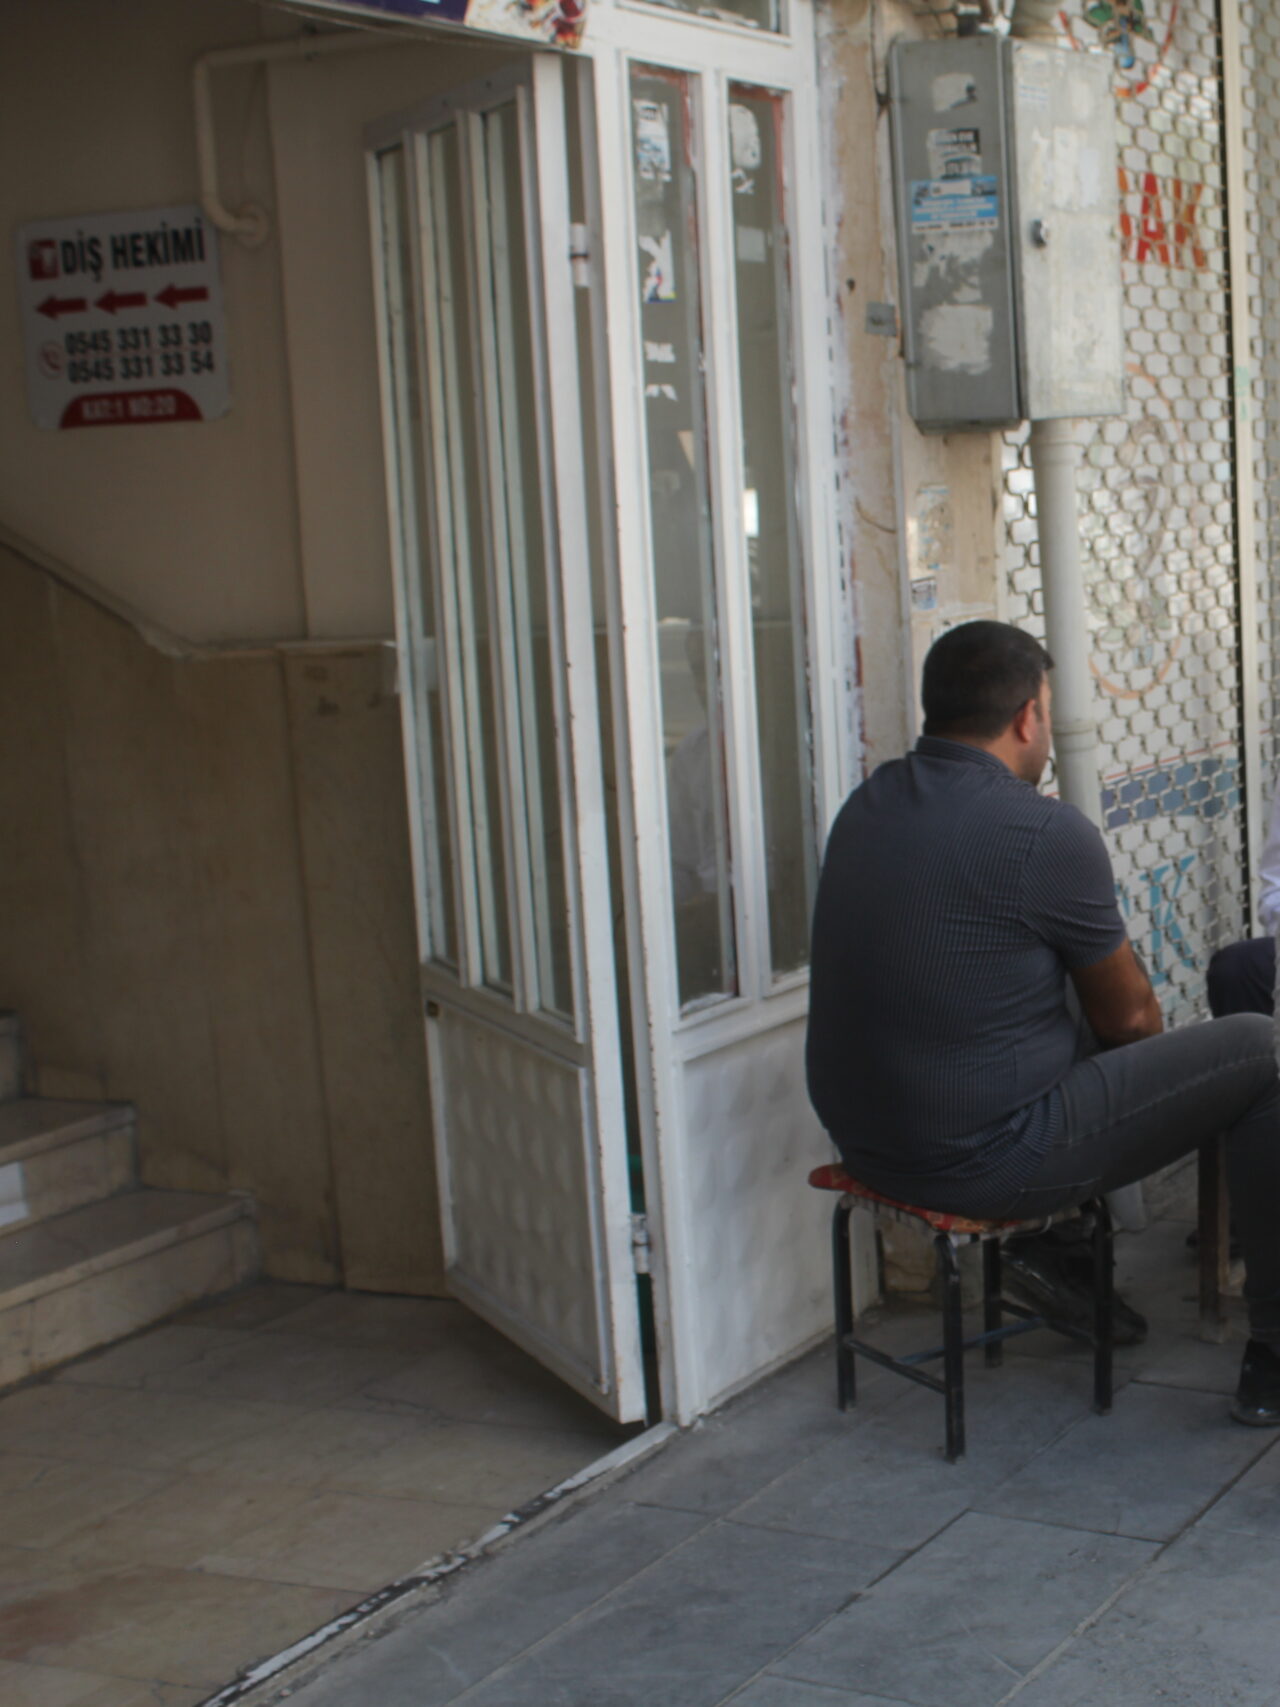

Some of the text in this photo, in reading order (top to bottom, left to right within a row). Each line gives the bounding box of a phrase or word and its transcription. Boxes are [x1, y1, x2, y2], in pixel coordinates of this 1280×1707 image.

[61, 217, 206, 283] DİŞ HEKİMİ
[65, 321, 213, 355] 0545 331 33 30
[68, 350, 214, 384] 0545 331 33 54
